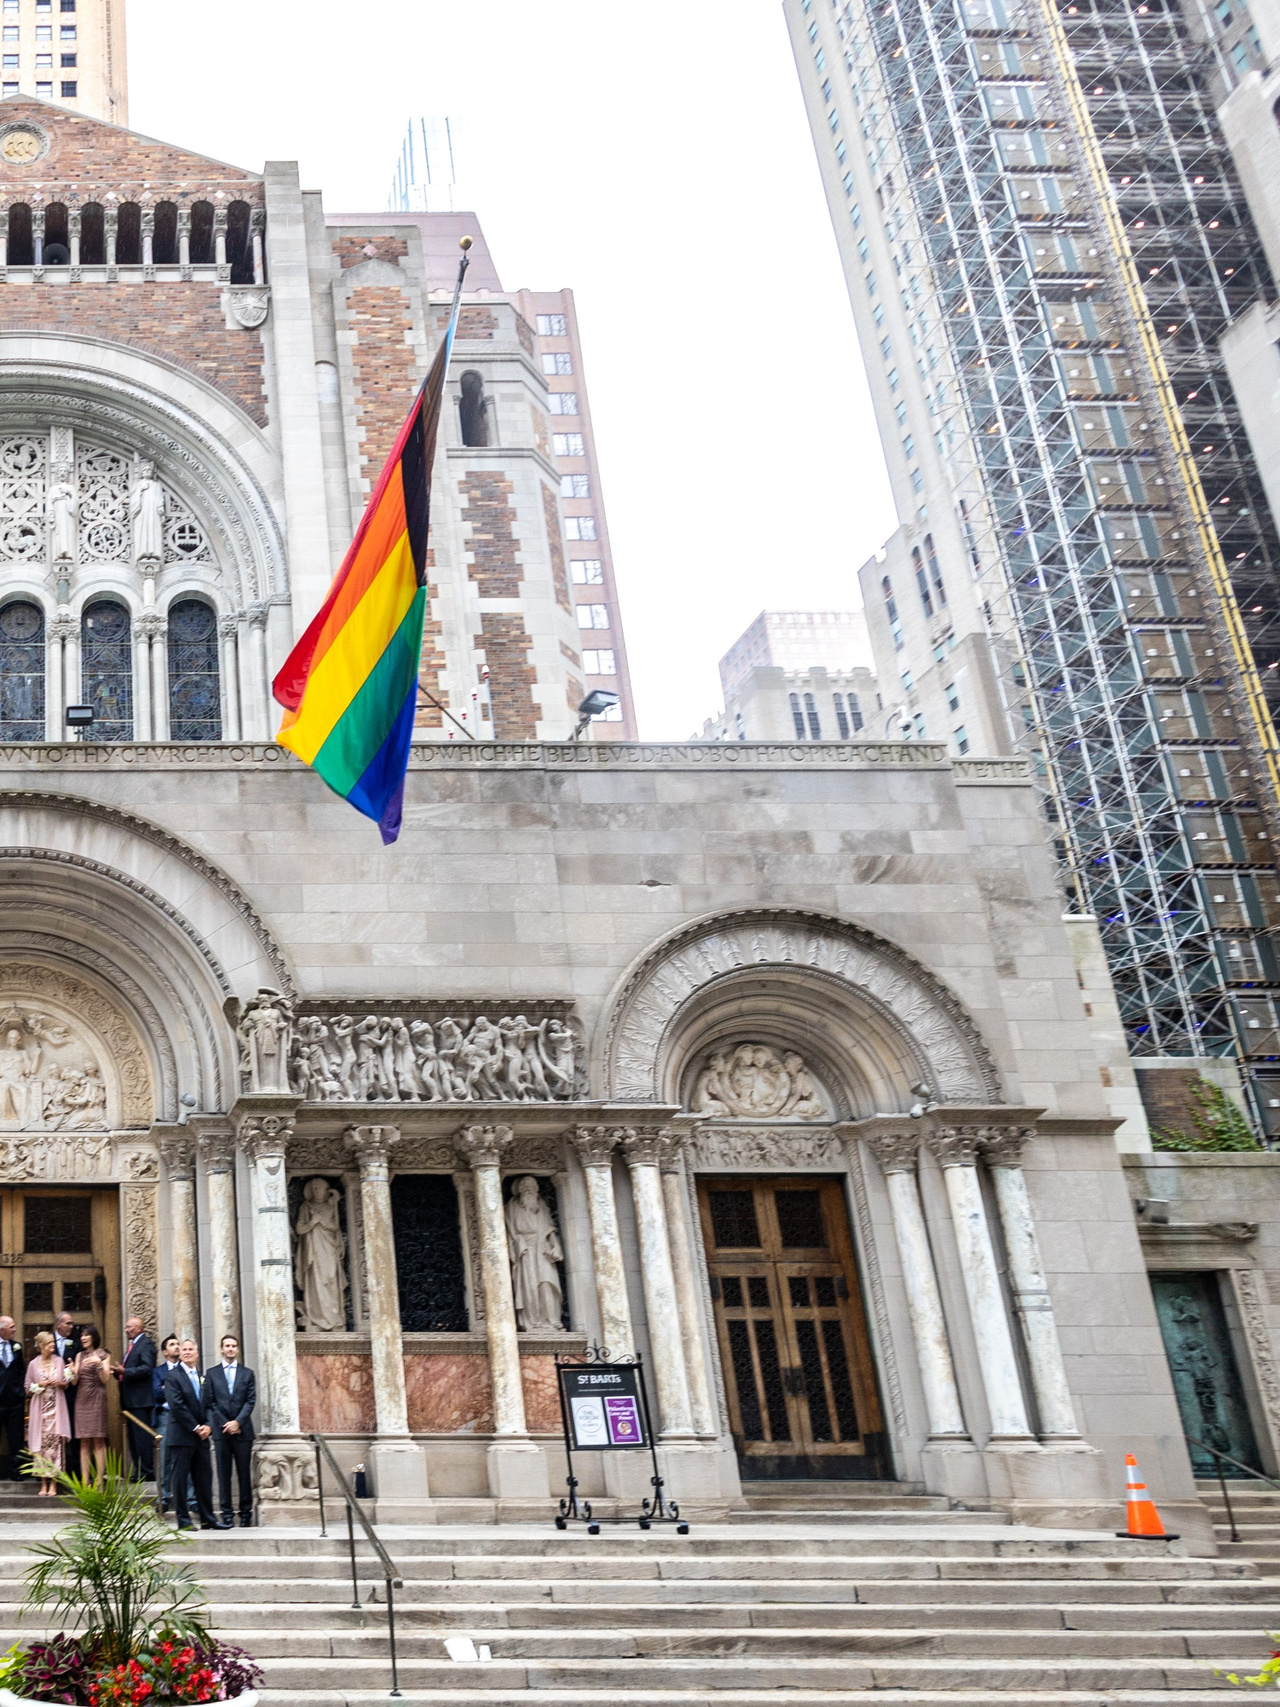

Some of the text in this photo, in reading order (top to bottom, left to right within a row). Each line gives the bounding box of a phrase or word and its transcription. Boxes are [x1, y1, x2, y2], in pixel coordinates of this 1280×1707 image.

[2, 747, 63, 763] VNTO
[69, 747, 115, 763] THY
[121, 746, 209, 763] CHVRCH
[214, 747, 246, 762] TO
[251, 747, 303, 762] LOV
[438, 746, 508, 762] WHICH
[511, 746, 541, 762] HE
[547, 747, 654, 763] BELIEVED
[659, 747, 705, 763] AND
[710, 747, 771, 762] BOTH
[774, 746, 805, 762] TO
[808, 746, 895, 762] PREACH
[898, 746, 945, 762] AND
